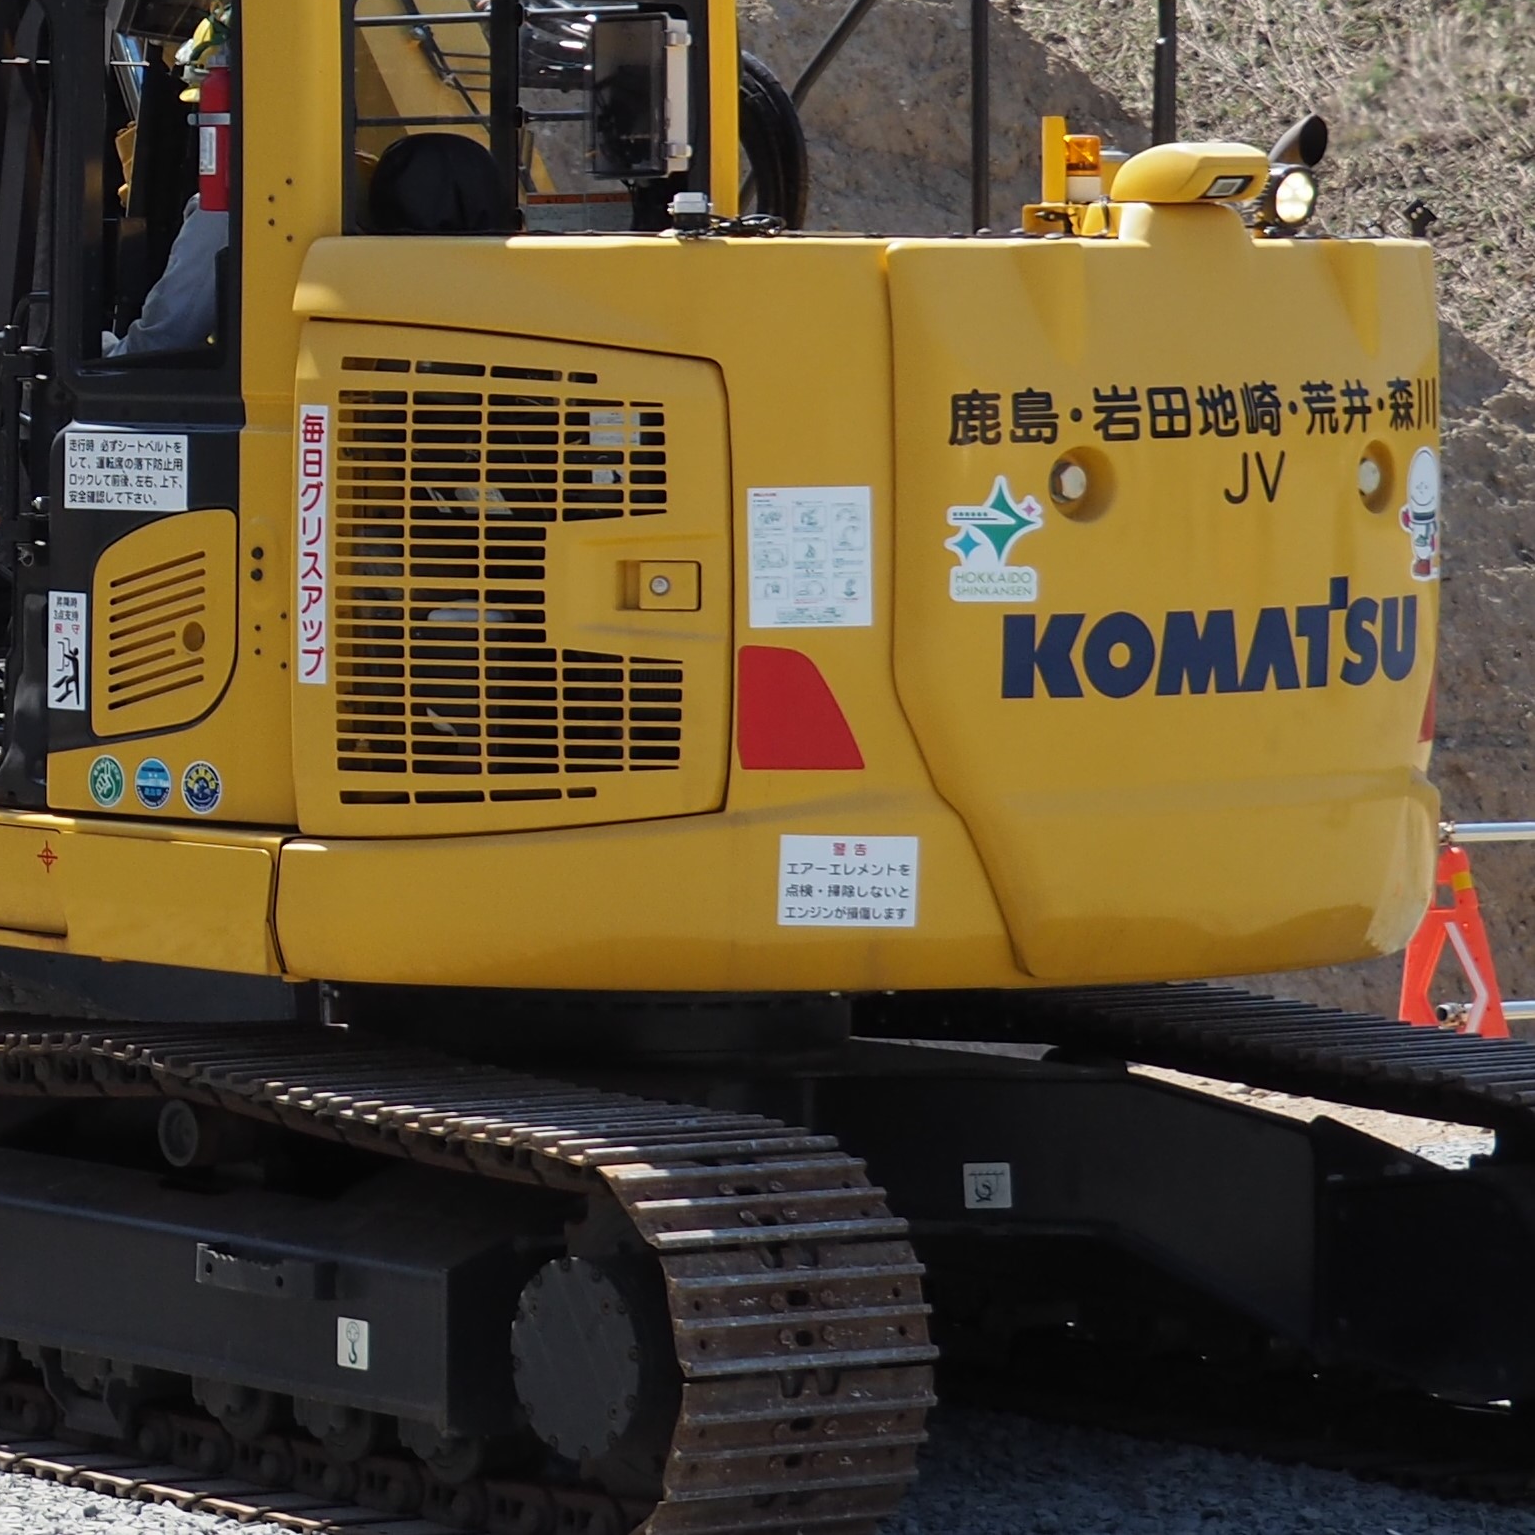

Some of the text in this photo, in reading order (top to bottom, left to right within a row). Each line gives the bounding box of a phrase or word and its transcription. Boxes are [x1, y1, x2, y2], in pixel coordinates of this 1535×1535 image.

[948, 375, 1437, 446] 鹿島・岩田地崎・荒井・森川
[1224, 450, 1285, 504] JV
[301, 413, 325, 677] 毎日グリスアップ
[955, 571, 1031, 583] HOKKAIDO
[955, 585, 1031, 596] SHINKANSEN
[1001, 575, 1417, 699] KOMATSU
[786, 862, 910, 876] エアーエレメントを
[785, 884, 910, 898] 点検・掃除しないと
[784, 906, 907, 920] エンジンが損傷します
